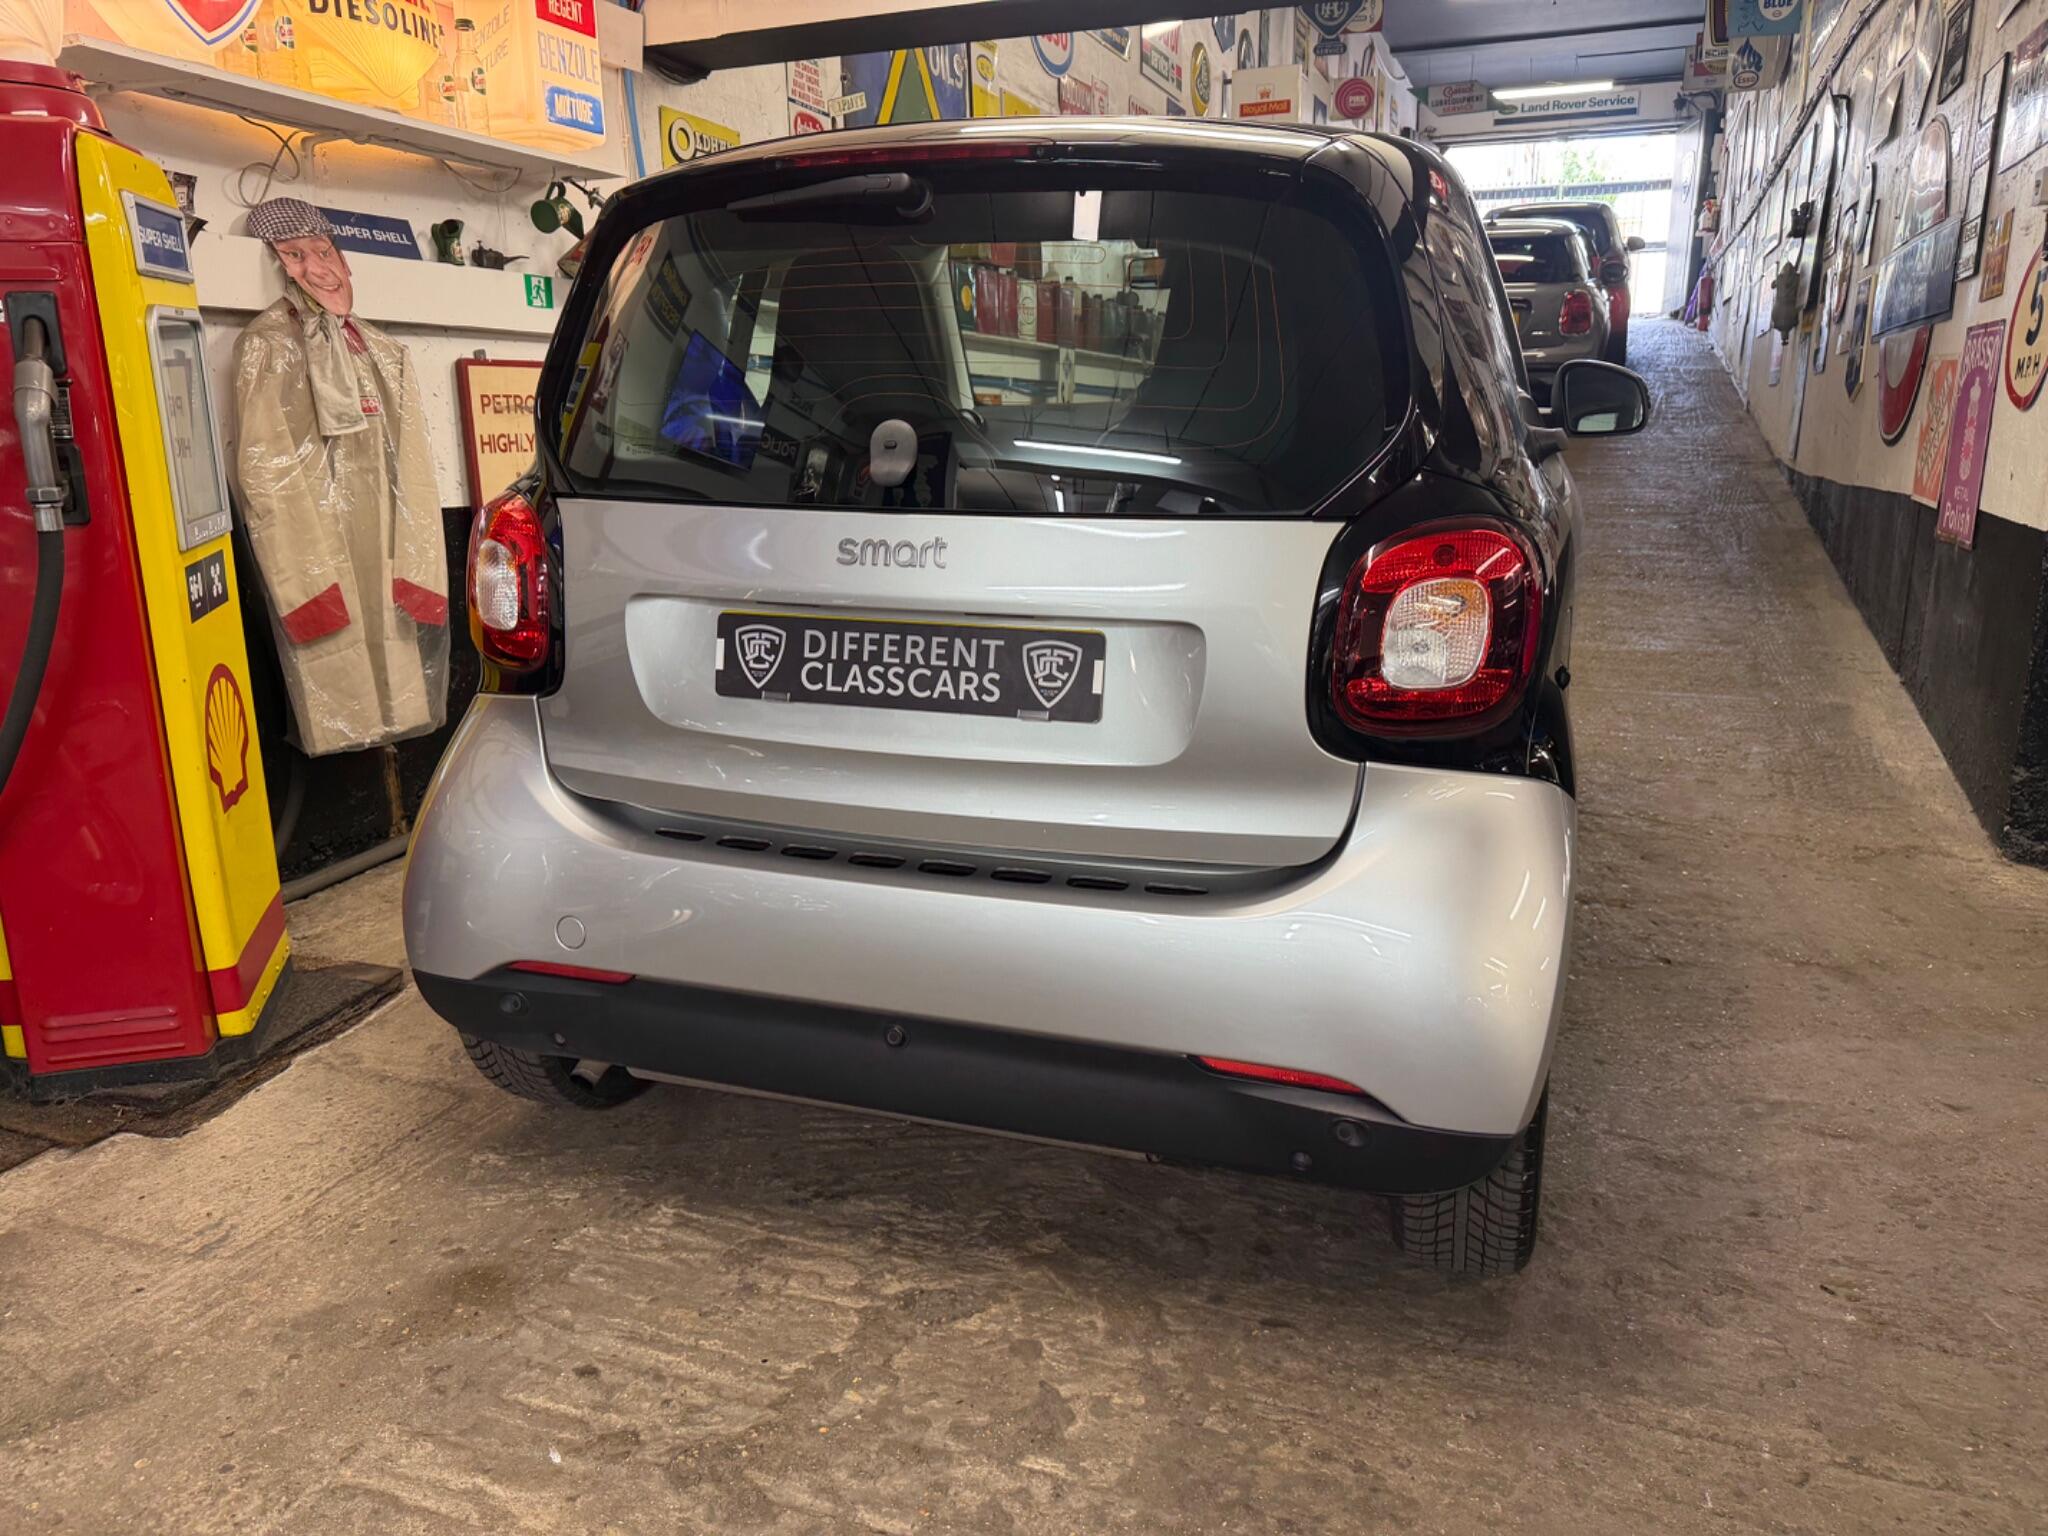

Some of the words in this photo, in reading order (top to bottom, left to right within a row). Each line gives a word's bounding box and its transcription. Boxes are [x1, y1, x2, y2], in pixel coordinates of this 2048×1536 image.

[537, 29, 600, 85] BENZOLE
[928, 45, 964, 90] OILS
[1737, 75, 1755, 85] Esso
[554, 92, 594, 125] MIXTURE
[1243, 105, 1268, 115] Royal
[1270, 103, 1288, 111] Mail
[1521, 102, 1549, 114] Land
[1552, 99, 1587, 111] Rover
[1588, 95, 1635, 108] Service
[138, 225, 162, 249] SUPER
[161, 232, 184, 252] SHELL
[330, 224, 369, 243] SUPER
[372, 229, 412, 245] SHELL
[2025, 268, 2048, 346] 5
[480, 394, 535, 414] PETRO
[480, 433, 535, 453] HIGHLY
[1945, 504, 1970, 535] Polish
[836, 536, 947, 568] smart
[804, 628, 1005, 668] DIFFERENT
[801, 662, 1001, 702] CLASSCARS
